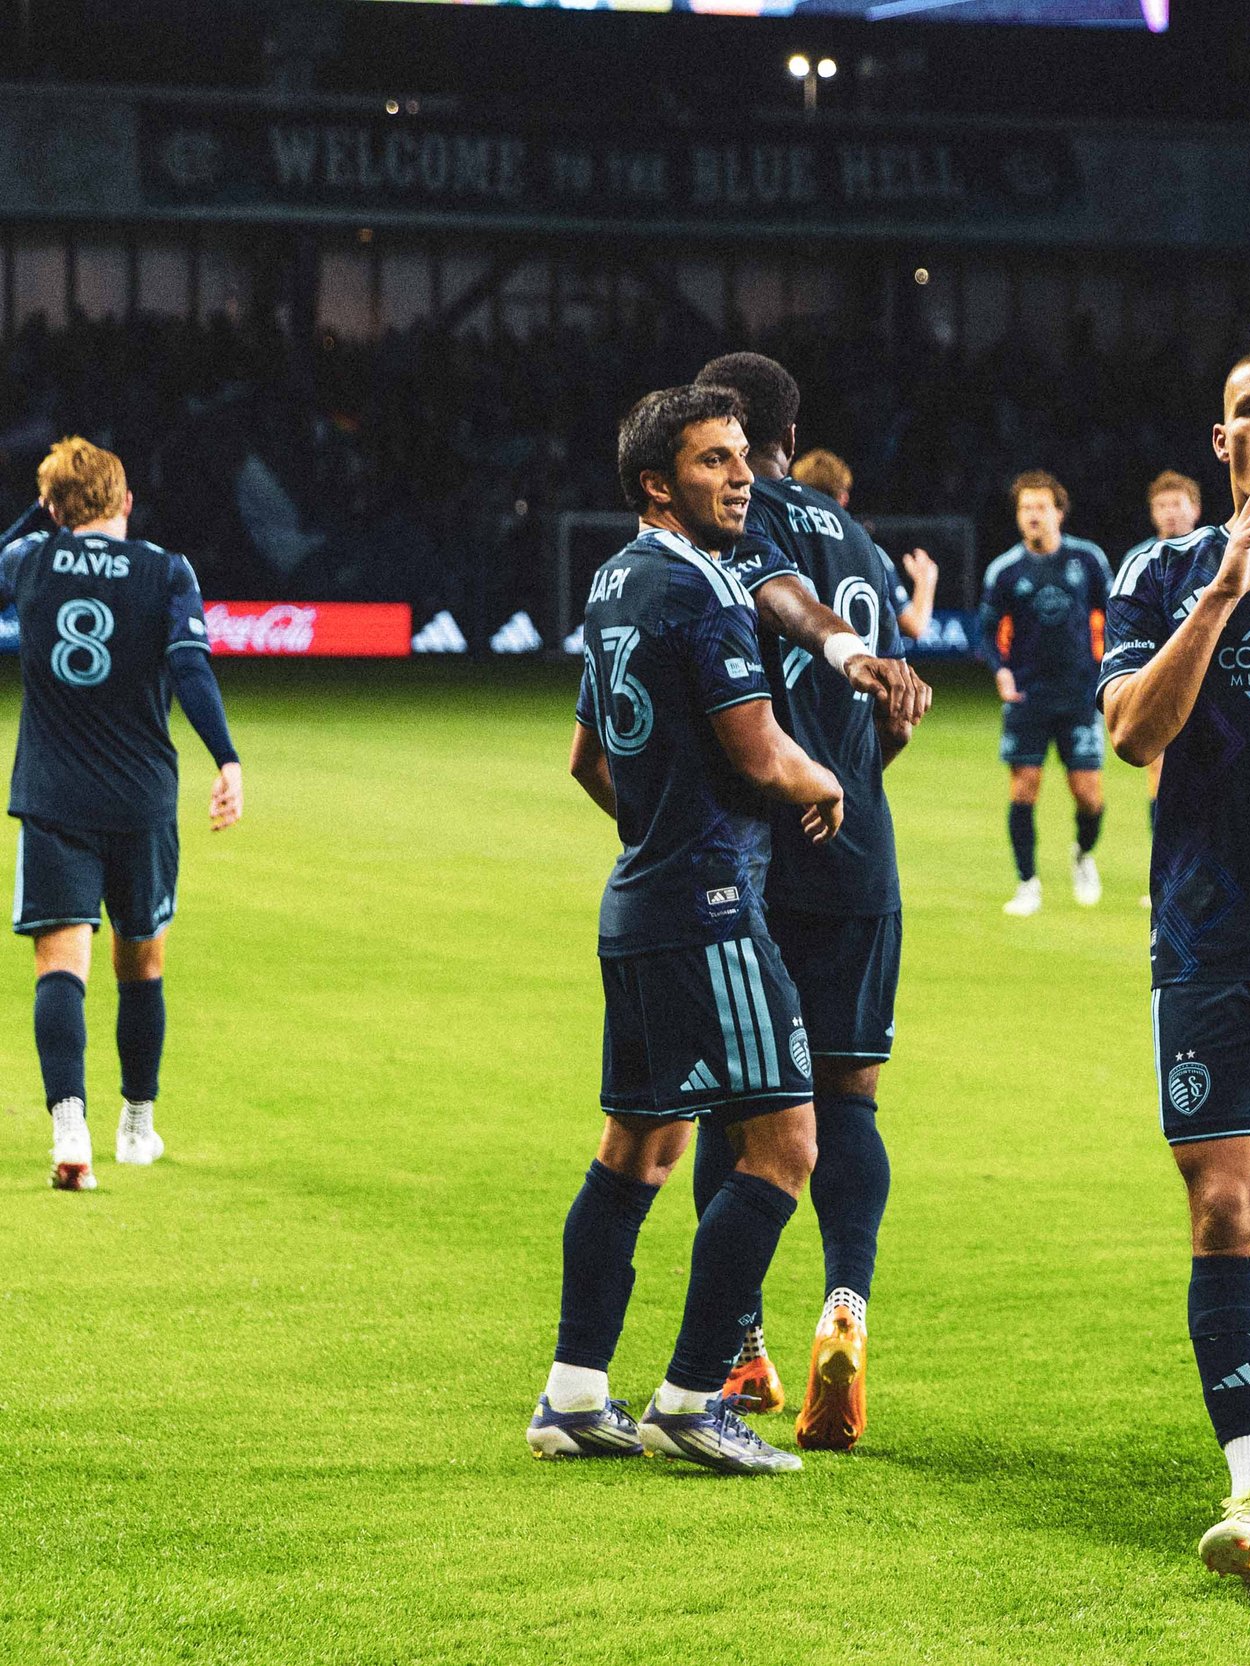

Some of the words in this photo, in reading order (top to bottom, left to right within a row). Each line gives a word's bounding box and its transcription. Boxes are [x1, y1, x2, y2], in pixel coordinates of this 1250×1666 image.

[268, 125, 527, 195] WELCOME
[692, 144, 817, 203] BLUE
[838, 142, 966, 199] HELL
[786, 502, 844, 540] REID
[52, 549, 130, 578] DAVIS
[50, 598, 115, 686] 8
[585, 626, 654, 756] 3
